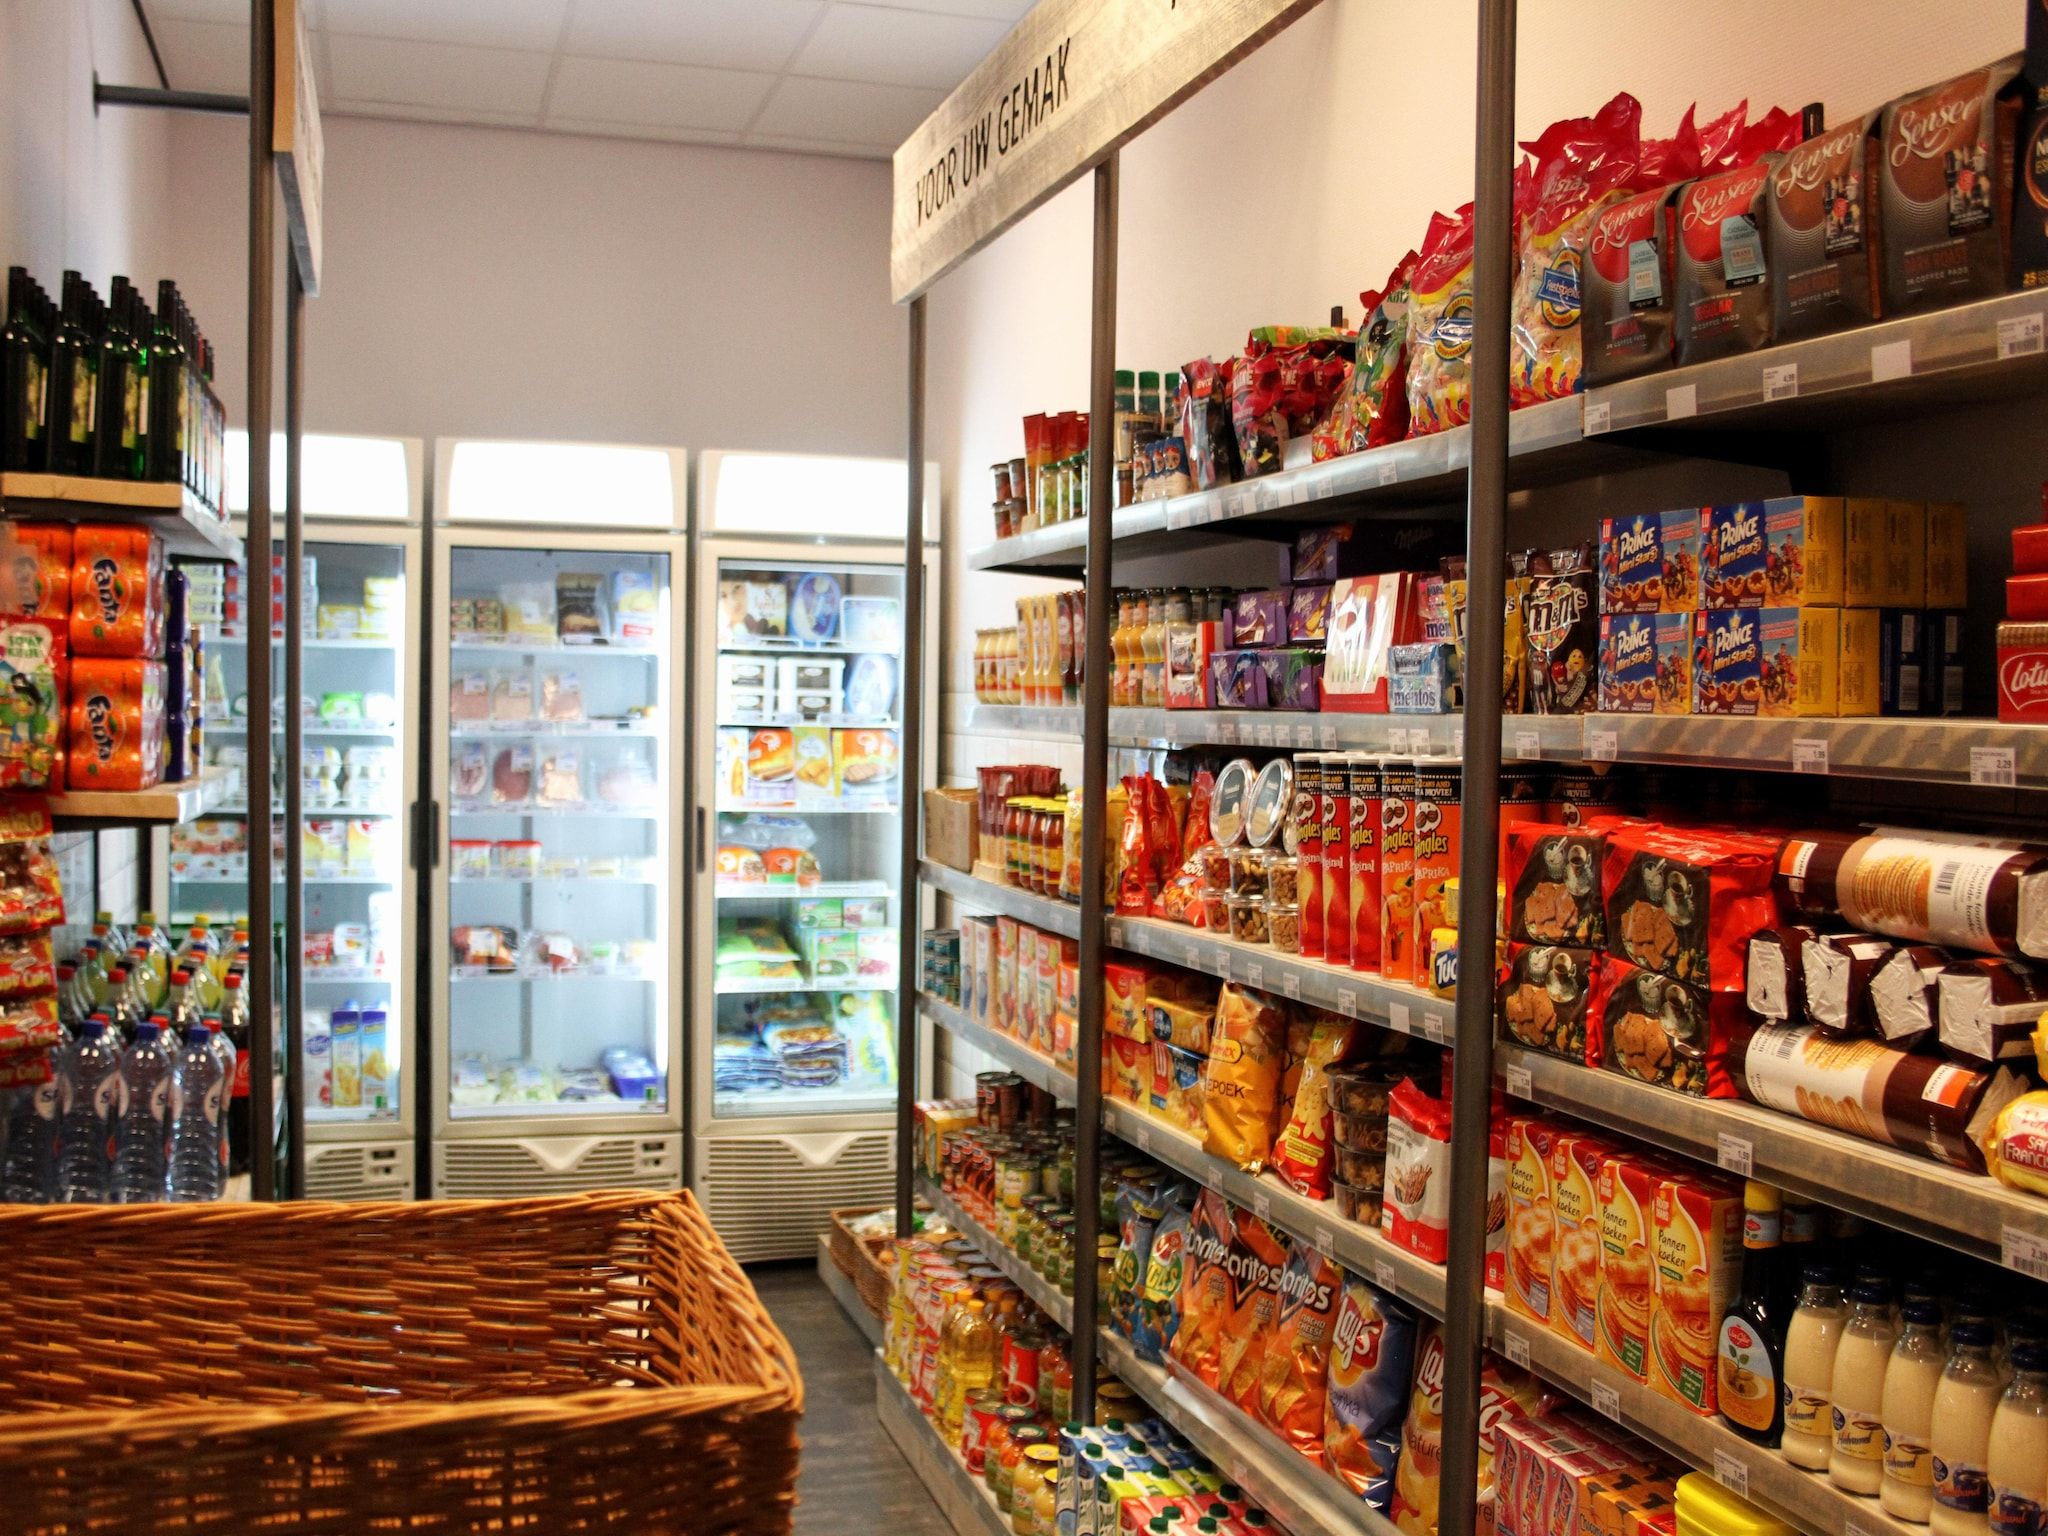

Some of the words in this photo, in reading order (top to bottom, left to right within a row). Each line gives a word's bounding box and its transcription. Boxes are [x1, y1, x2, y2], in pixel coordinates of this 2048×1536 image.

[915, 147, 956, 227] VOOR
[961, 111, 992, 188] UW
[998, 37, 1071, 157] GEMAK
[1620, 526, 1655, 560] PRINCE
[1719, 515, 1759, 552] PRINCE
[92, 556, 120, 625] Fanta
[1618, 626, 1651, 658] PRINCE
[1715, 622, 1754, 657] PRINCE
[2010, 660, 2048, 693] Lotu
[1394, 687, 1437, 707] mentos
[87, 694, 113, 763] Fanta
[1383, 824, 1414, 856] ingles
[1416, 832, 1448, 861] ingles
[1383, 859, 1414, 874] PAPRIK
[1206, 1079, 1246, 1100] EPOEK
[2005, 1142, 2048, 1169] FRANCI
[1511, 1162, 1534, 1183] Pannen
[1511, 1177, 1534, 1196] koeken
[1557, 1181, 1581, 1204] Pannen
[1557, 1197, 1581, 1218] koeken
[1602, 1204, 1628, 1228] Pannen
[1602, 1221, 1628, 1242] koeken
[1658, 1229, 1687, 1254] Pannen
[1657, 1244, 1687, 1270] koeken
[1228, 1253, 1283, 1291] oritos
[1282, 1264, 1331, 1311] oritos
[1409, 1433, 1442, 1462] ature
